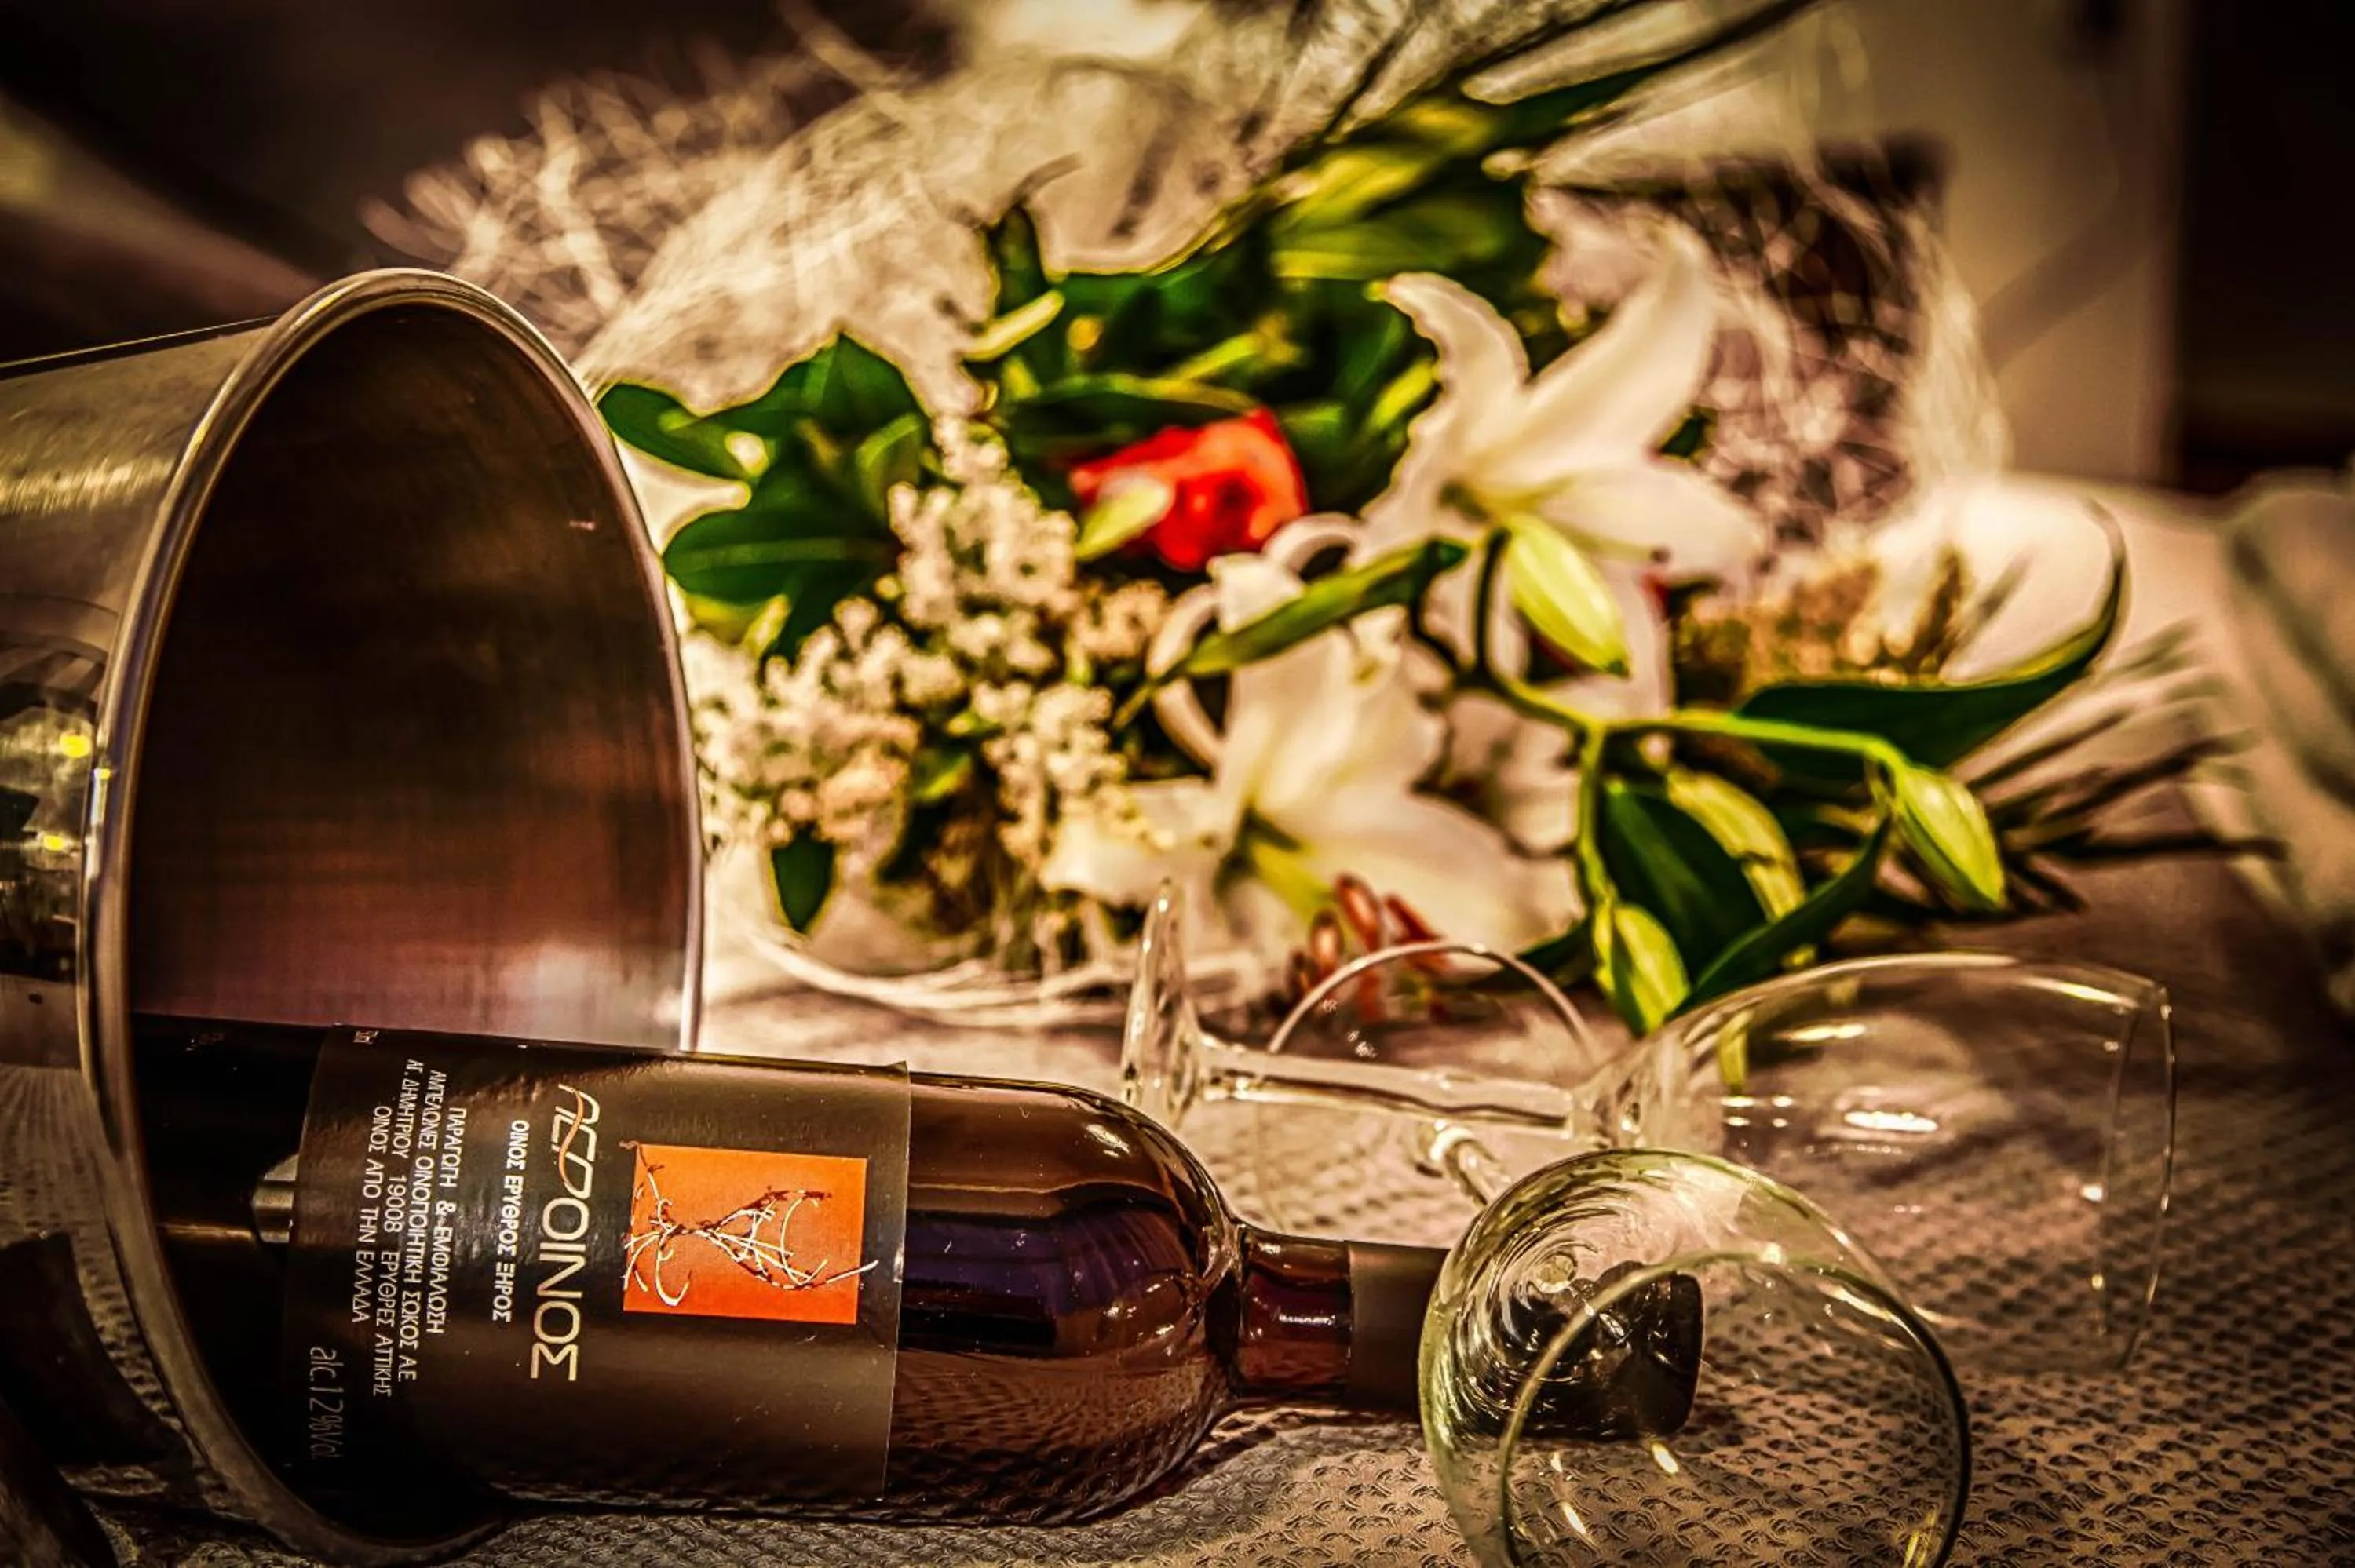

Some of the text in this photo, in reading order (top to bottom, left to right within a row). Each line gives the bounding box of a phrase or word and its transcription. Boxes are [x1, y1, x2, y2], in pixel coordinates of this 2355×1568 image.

[418, 1070, 447, 1150] ΑΜΠΕΛΩΝΕΣ
[351, 1106, 392, 1322] ΟΙΝΟΣ ΑΠΟ ΤΗΝ ΕΛΛΑΔΑ
[373, 1059, 423, 1397] ΑΓ. ΔΗΜΗΤΡΙΟΥ 19008 ΕΡΥΘΡΕΣ ΑΤΤΙΚΗΣ
[403, 1156, 434, 1283] ΟΙΝΟΠΟΙΗΤΙΚΗ
[426, 1107, 466, 1333] ΠΑΡΑΓΩΓΗ & ΕΜΦΙΑΛΩΣΗ
[492, 1119, 530, 1322] ΟΙΝΟΣ ΕΡΥΘΡΟΣ ΞΗΡΟΣ
[399, 1290, 421, 1350] ΣΩΚΟΣ
